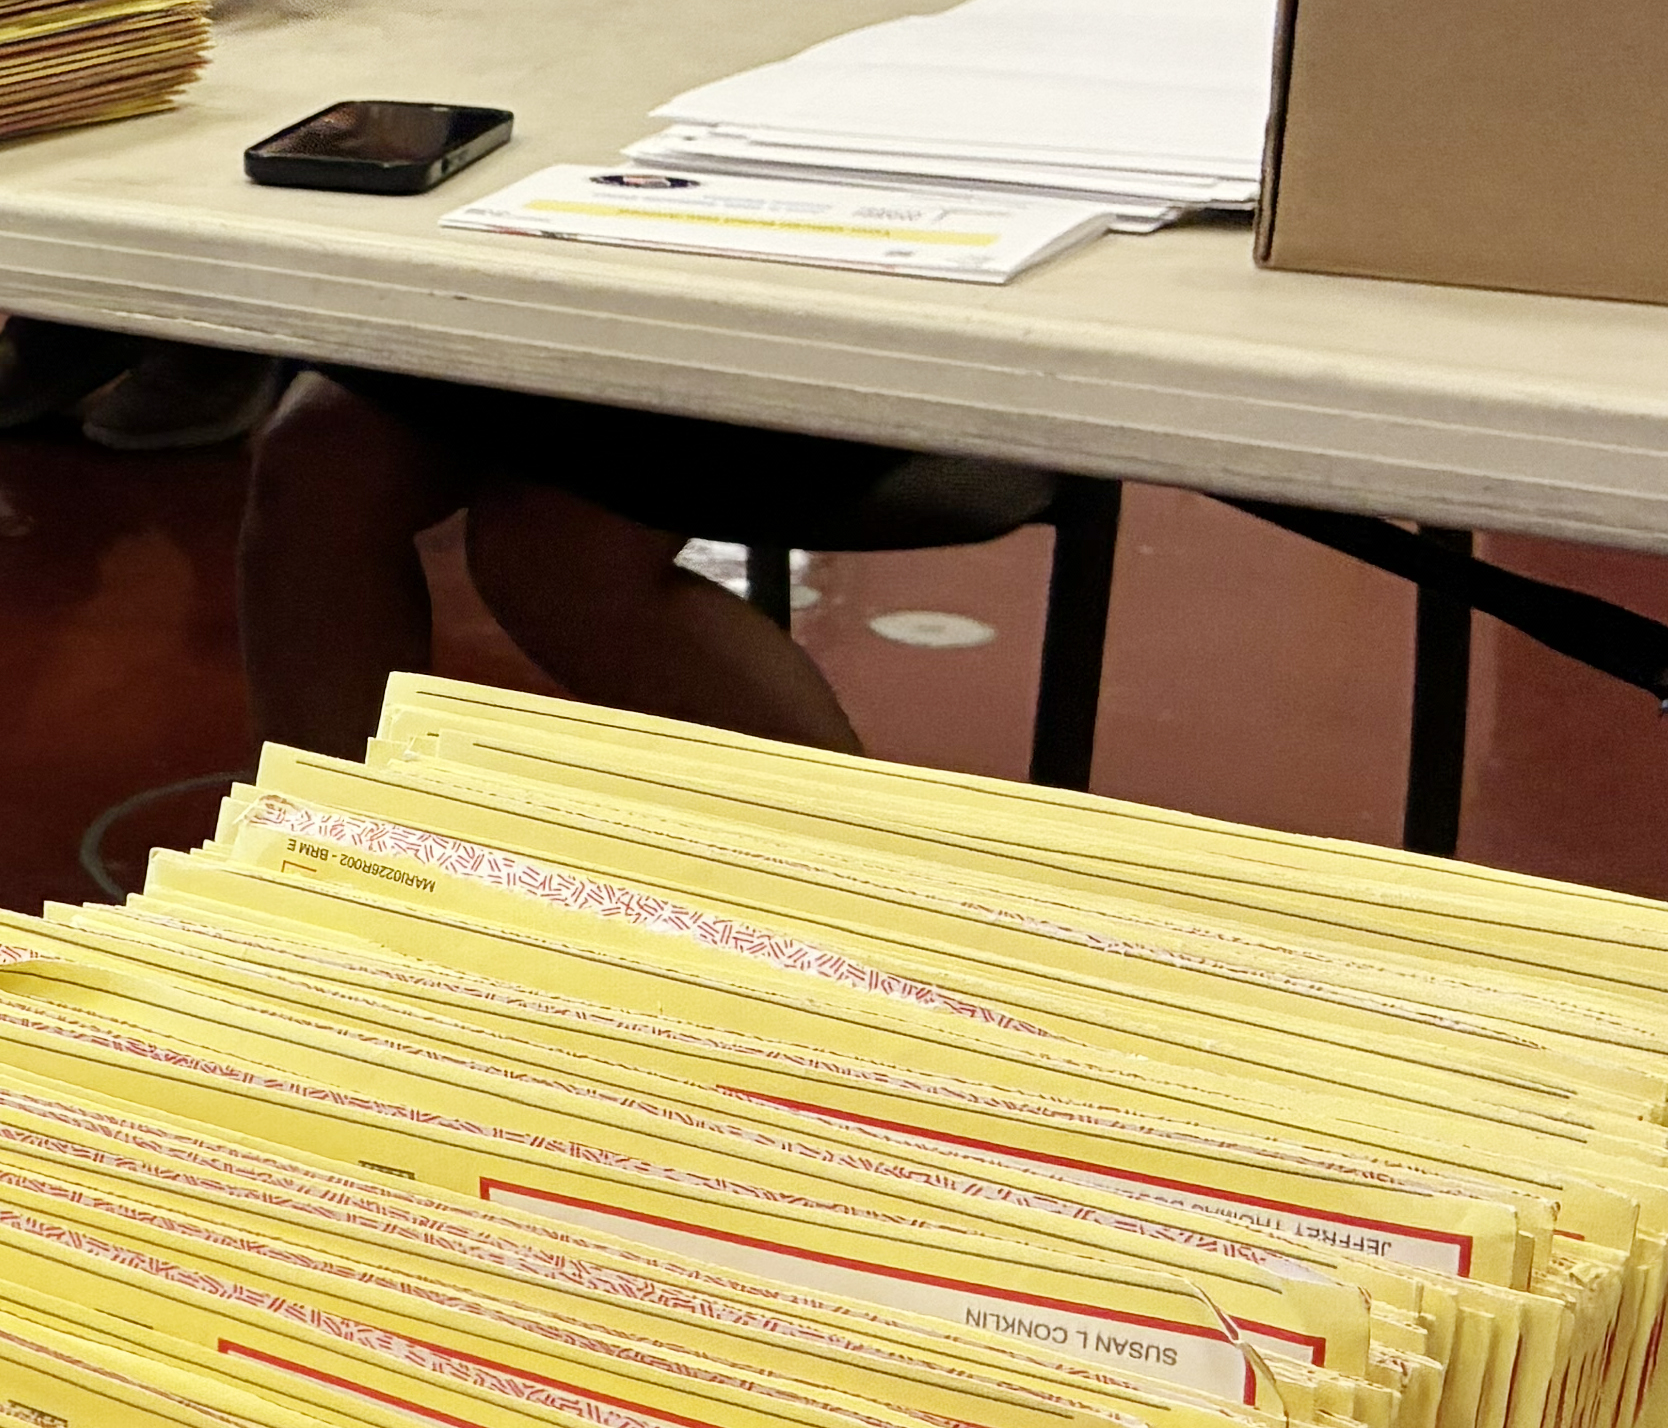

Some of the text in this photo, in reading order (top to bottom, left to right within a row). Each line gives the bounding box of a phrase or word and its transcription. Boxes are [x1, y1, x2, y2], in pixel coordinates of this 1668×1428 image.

[287, 838, 296, 851] E
[299, 842, 329, 861] BRM
[964, 1306, 1179, 1367] SUSAN L CONKLIN
